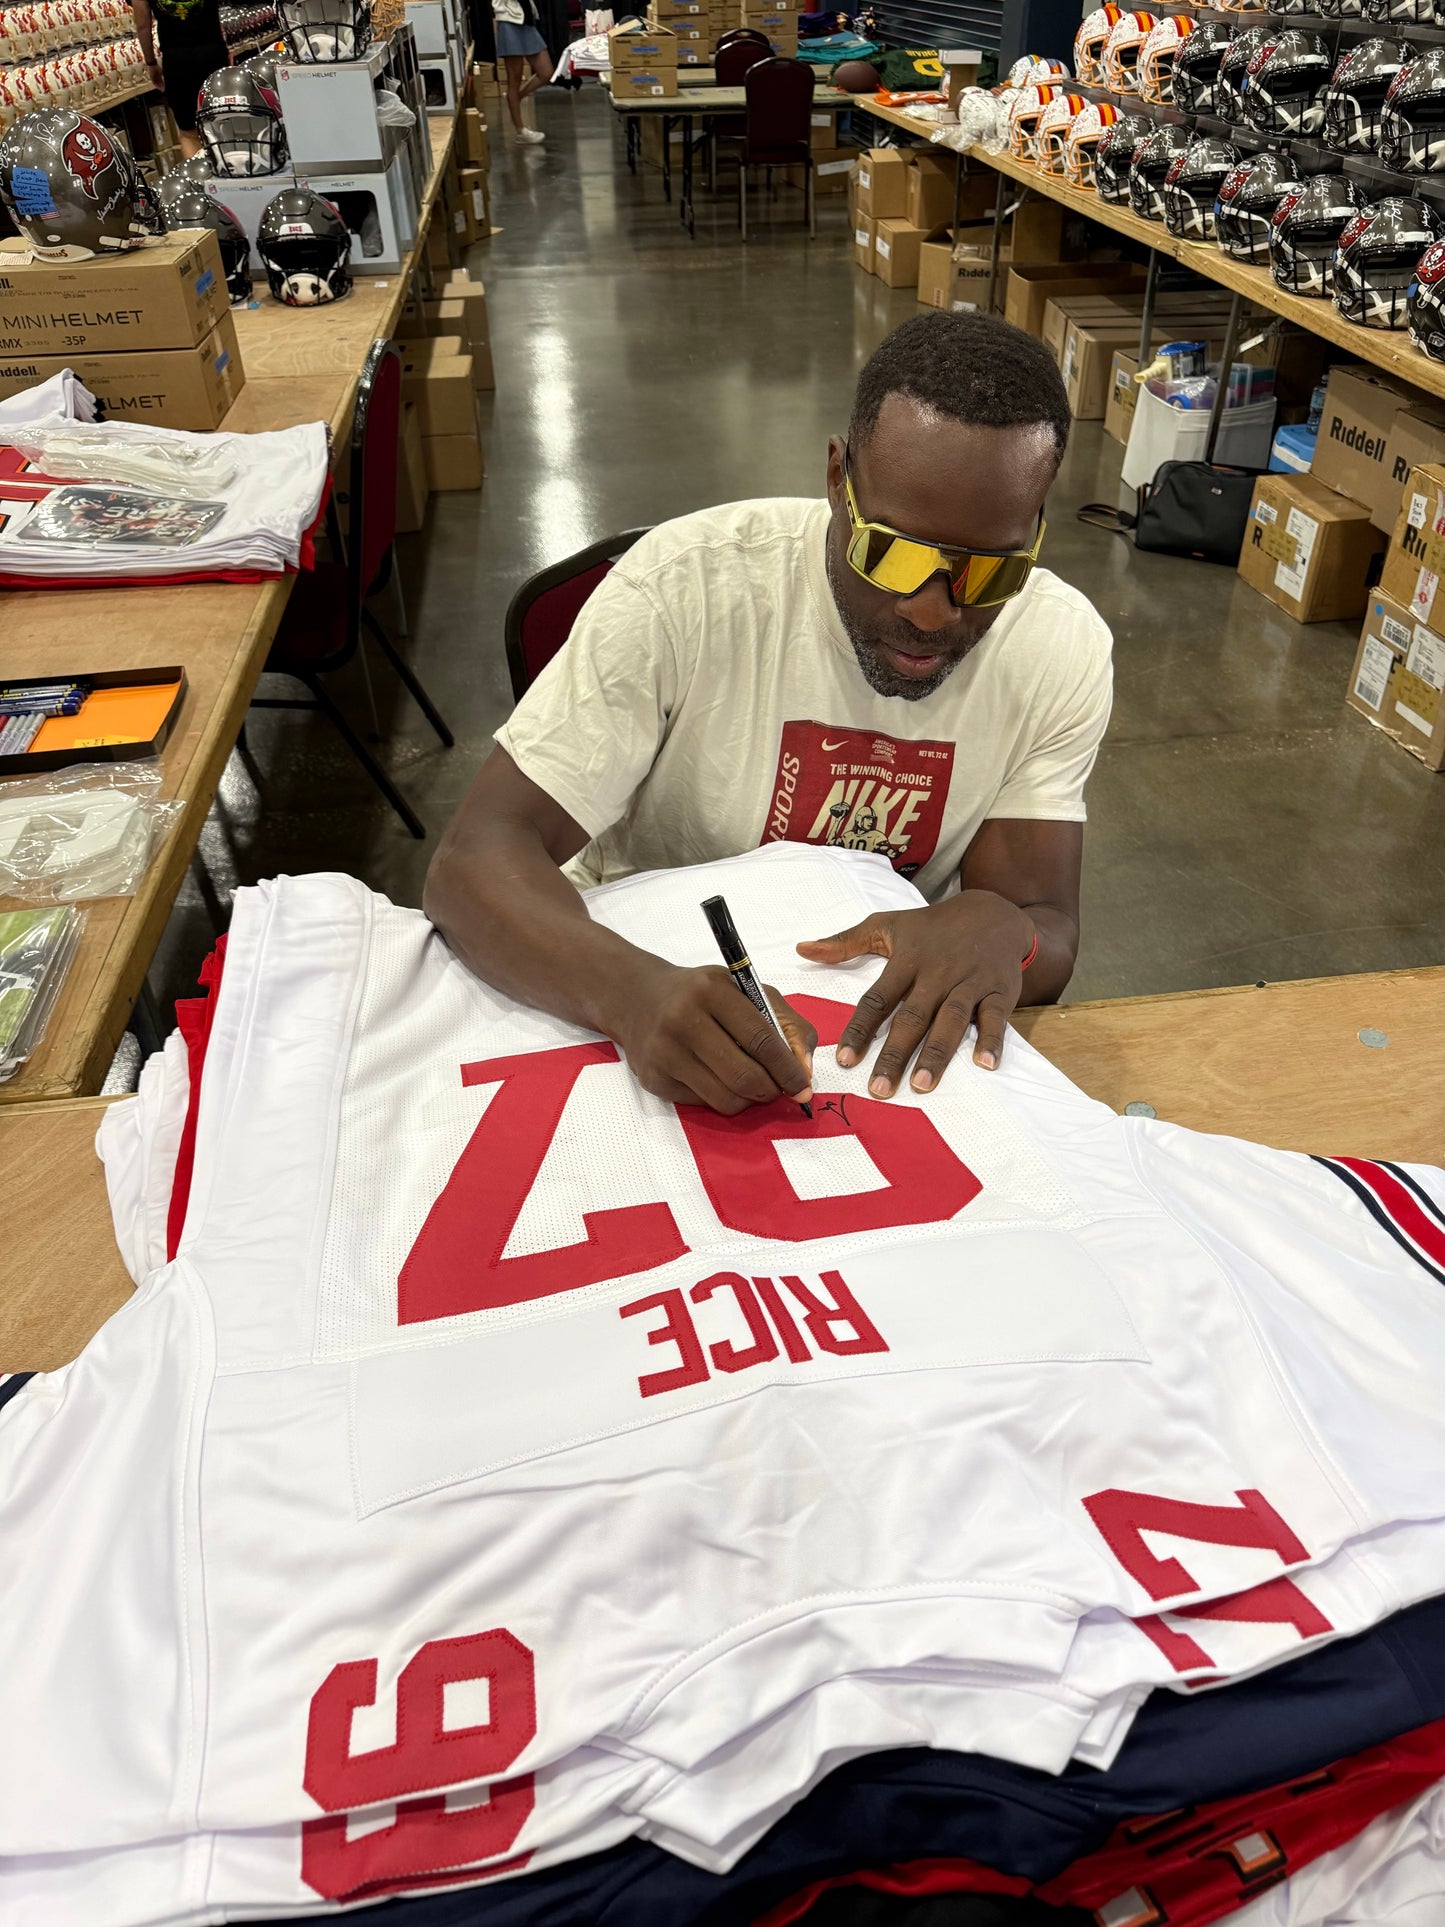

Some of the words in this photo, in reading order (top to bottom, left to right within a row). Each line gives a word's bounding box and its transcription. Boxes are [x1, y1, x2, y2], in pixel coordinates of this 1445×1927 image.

[958, 268, 991, 278] Ridde
[2, 314, 48, 330] MINI
[50, 310, 144, 328] HELMET
[106, 394, 167, 411] LMET
[1330, 416, 1387, 463] Riddell
[918, 750, 928, 758] NET
[830, 763, 847, 775] THE
[850, 764, 893, 783] WINNING
[895, 773, 933, 787] CHOICE
[807, 779, 931, 845] NIKE
[618, 1269, 890, 1398] RICE
